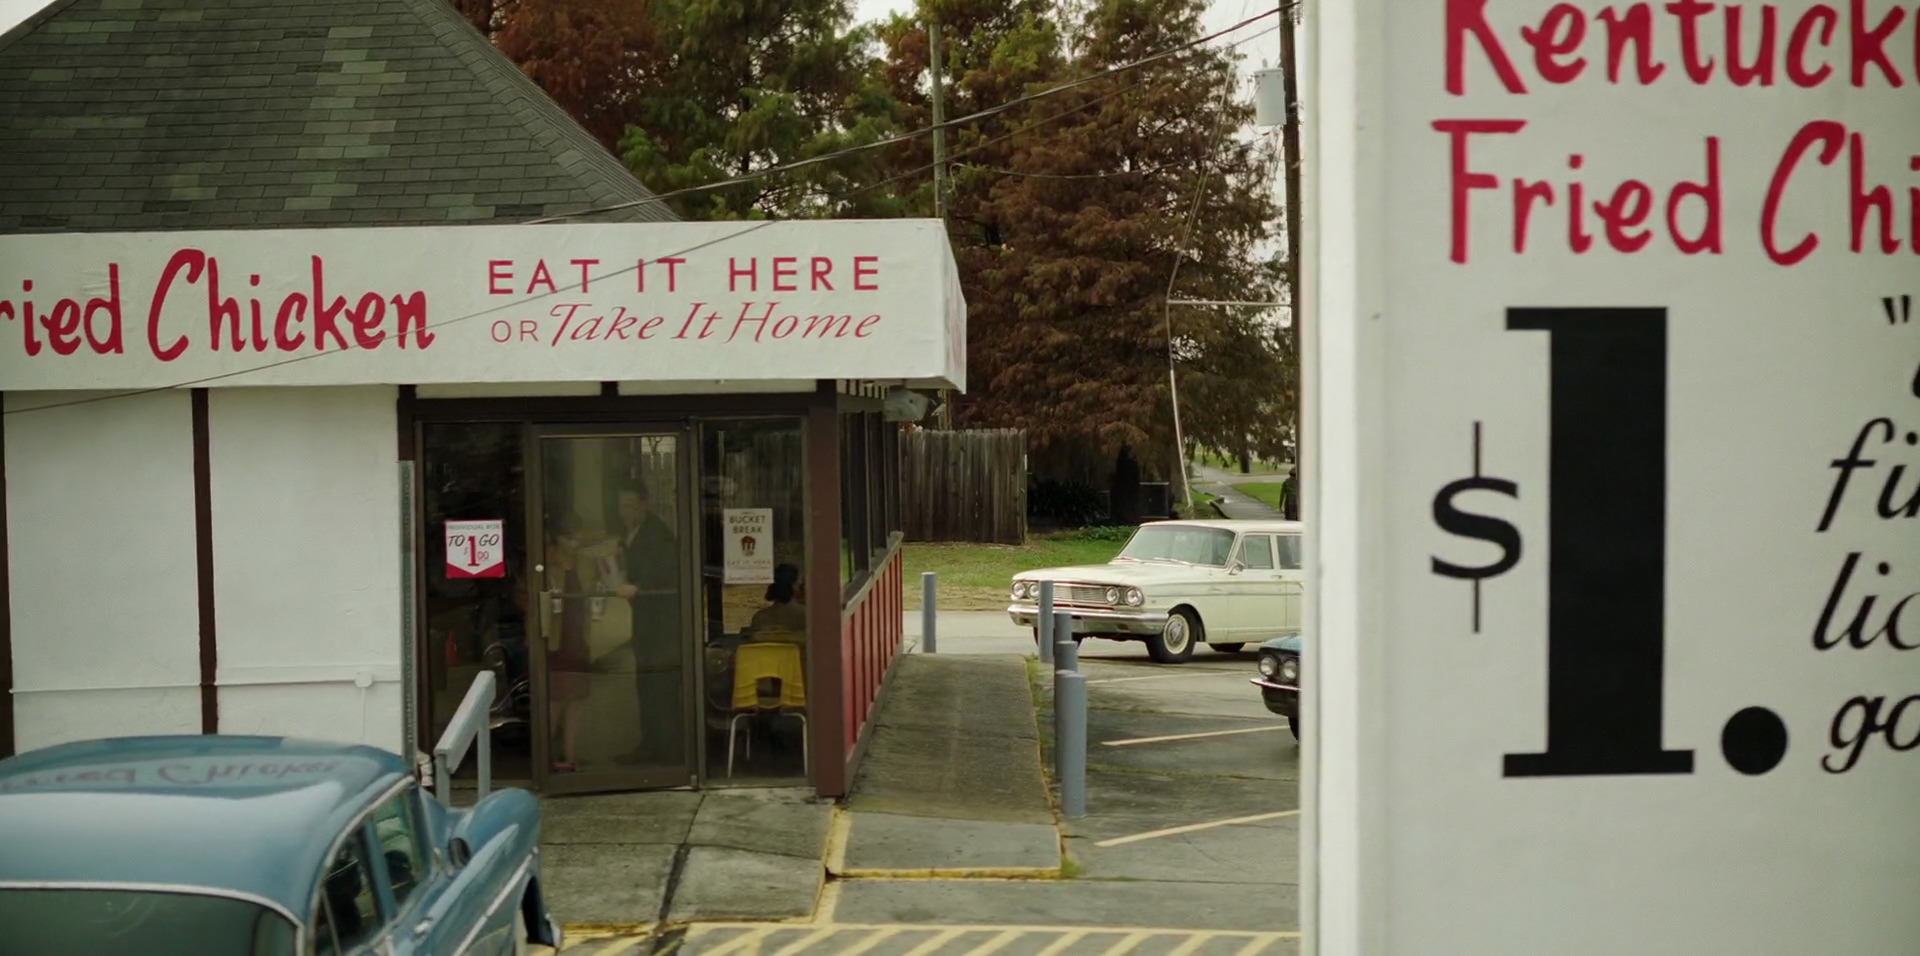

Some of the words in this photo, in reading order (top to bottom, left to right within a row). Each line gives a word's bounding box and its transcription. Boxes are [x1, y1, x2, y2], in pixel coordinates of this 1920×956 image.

[1444, 0, 1920, 96] Kentuck
[1430, 119, 1723, 265] Fried
[488, 258, 599, 294] EAT
[637, 257, 686, 293] IT
[729, 256, 879, 292] HERE
[147, 248, 435, 362] Chicken
[491, 319, 539, 343] OR
[550, 302, 664, 348] Take
[671, 301, 722, 341] It
[726, 301, 881, 344] Home
[449, 534, 466, 547] TO
[479, 533, 500, 547] GO
[729, 514, 766, 524] BUCKET
[732, 525, 763, 534] BREAK
